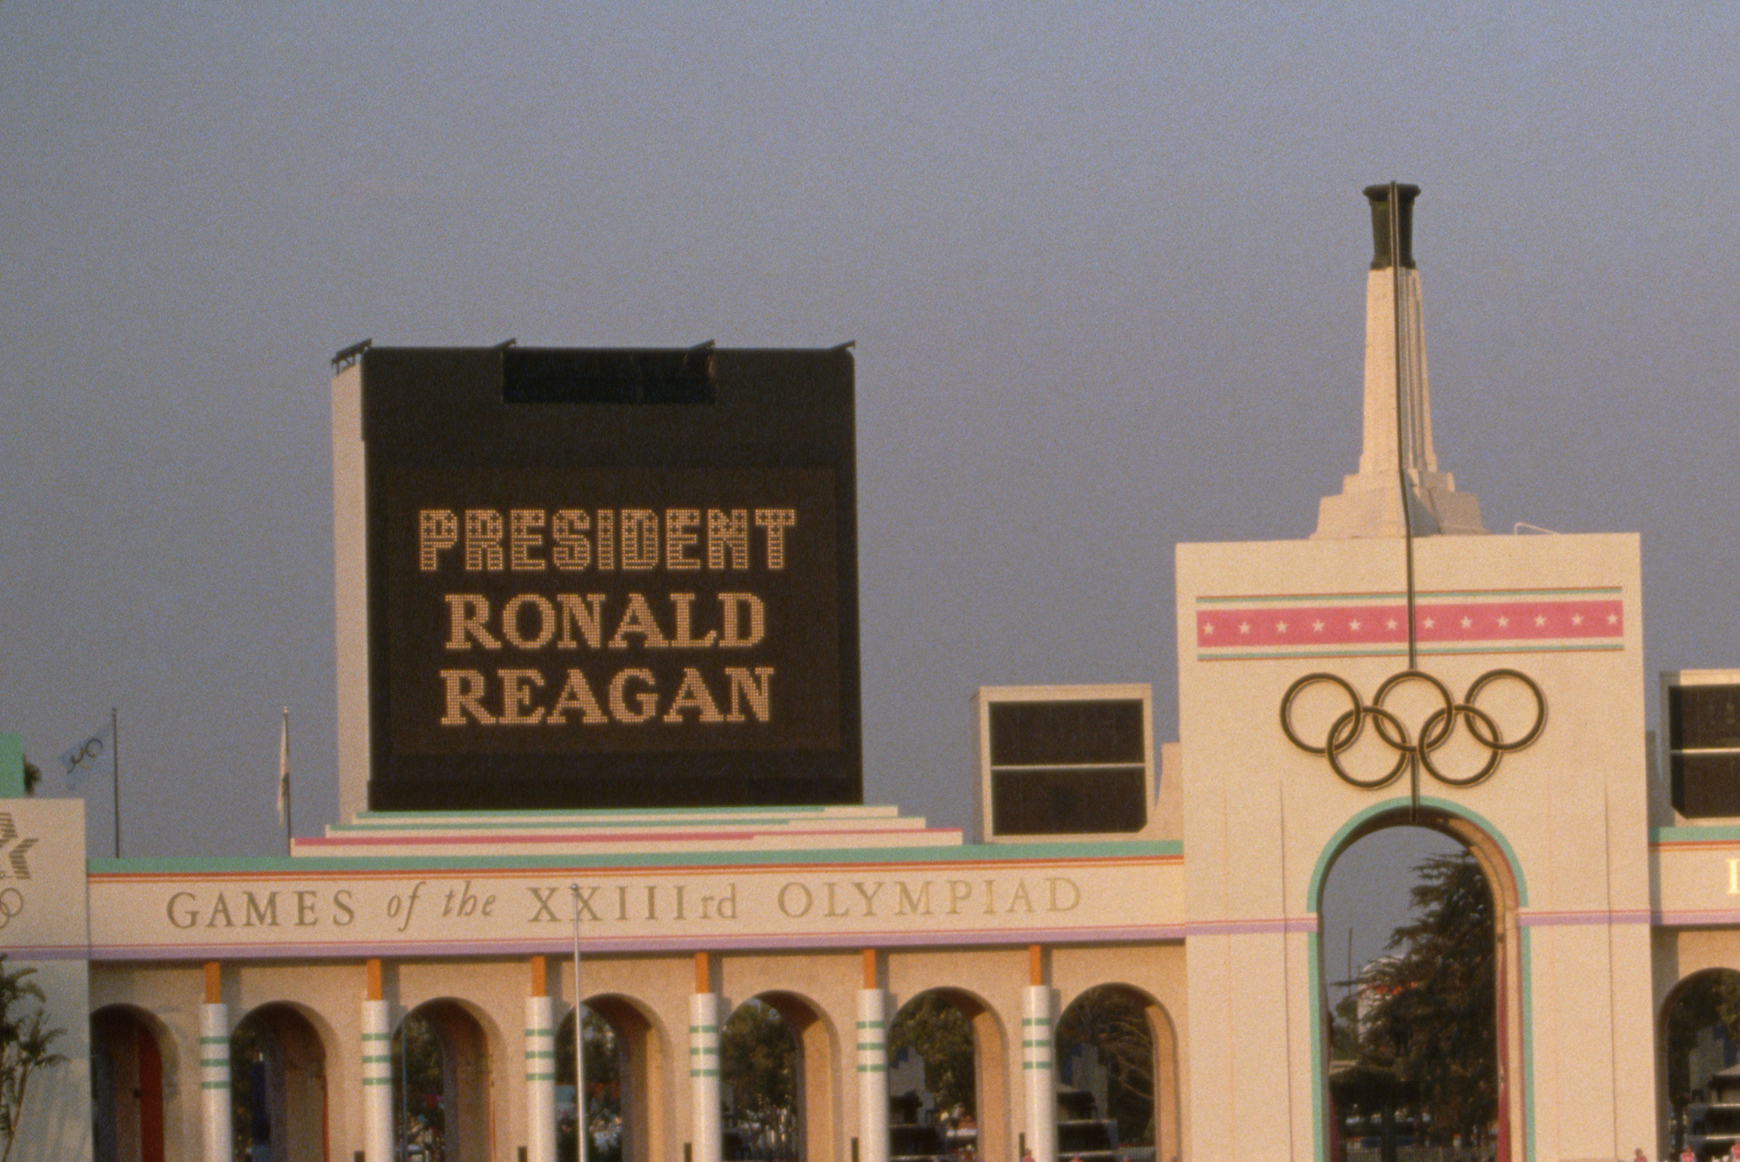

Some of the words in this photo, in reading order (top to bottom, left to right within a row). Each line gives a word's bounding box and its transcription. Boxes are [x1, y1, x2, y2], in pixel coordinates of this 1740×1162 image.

[418, 508, 797, 571] PRESIDENT
[444, 592, 767, 650] RONALD
[440, 666, 775, 726] REAGAN
[166, 889, 356, 928] GAMES
[386, 881, 427, 932] of
[441, 880, 498, 918] the
[526, 883, 739, 923] XXIIIrd
[776, 876, 1082, 918] OLYMPIAD
